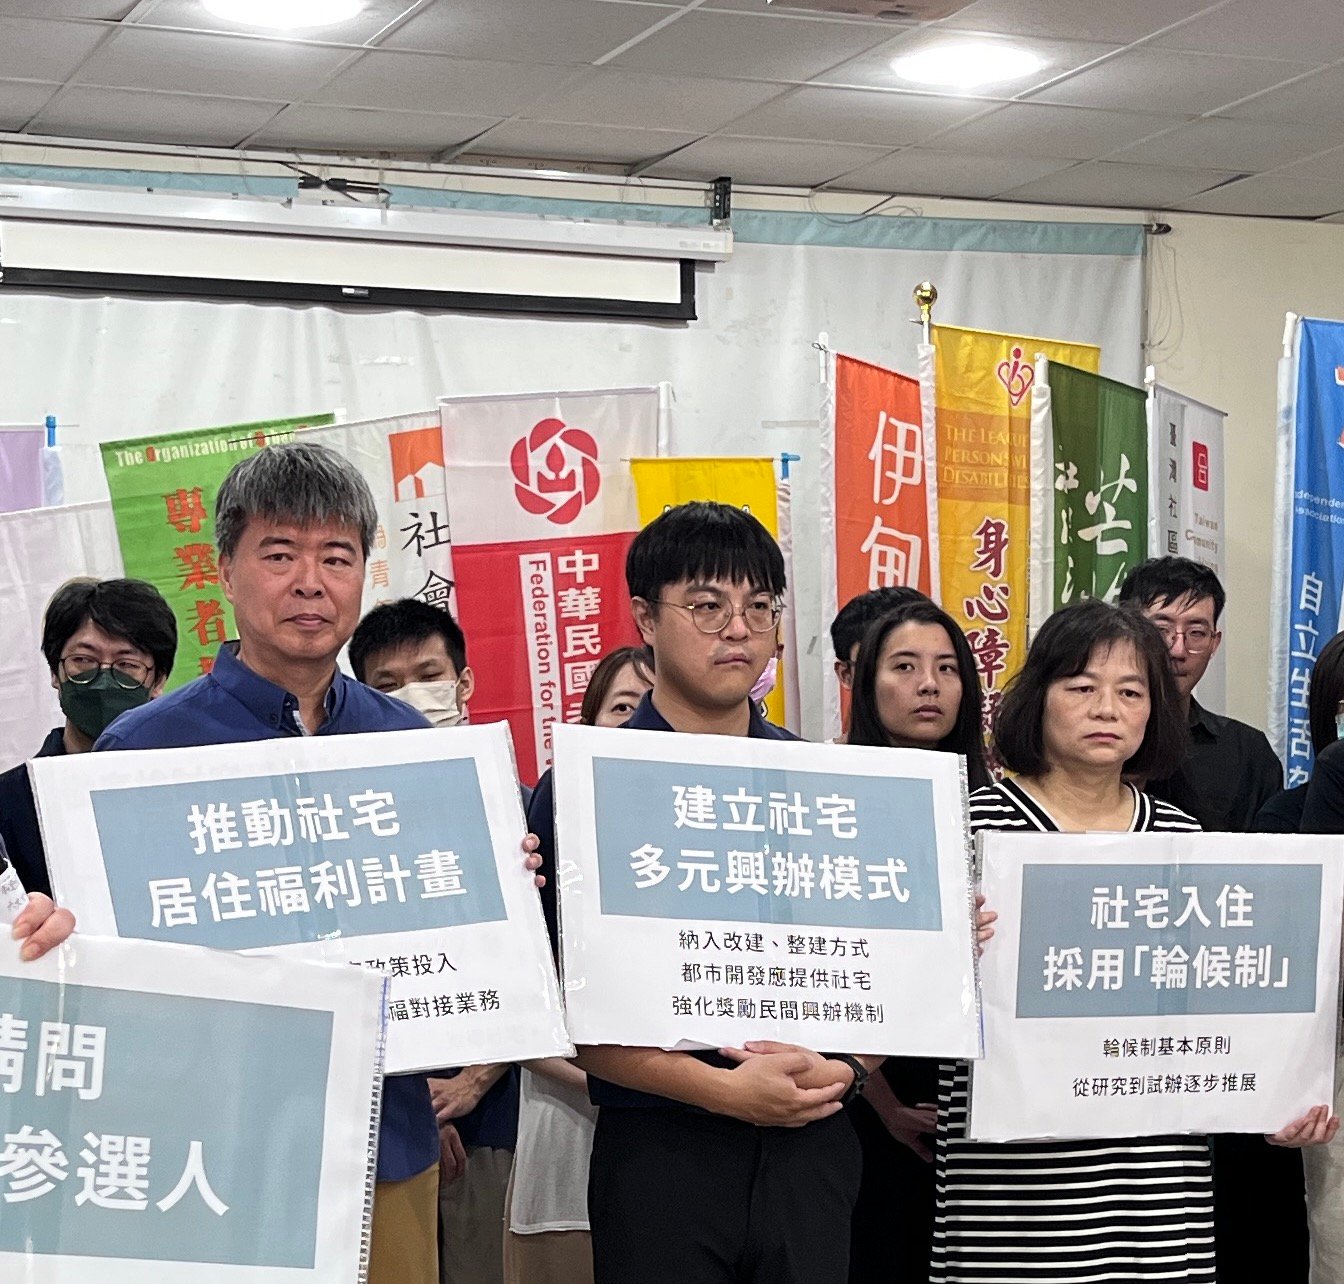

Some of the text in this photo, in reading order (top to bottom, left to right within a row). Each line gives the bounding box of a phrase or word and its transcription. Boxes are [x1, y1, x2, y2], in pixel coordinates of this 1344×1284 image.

[116, 450, 144, 467] The
[146, 439, 238, 463] Organization
[162, 486, 227, 676] 專業者
[528, 559, 554, 674] Federation
[539, 679, 556, 710] for
[187, 789, 400, 855] 推動社宅
[672, 785, 858, 839] 建立社宅
[148, 849, 467, 928] 居住福利計畫
[630, 843, 910, 903] 多元興辦模式
[1090, 884, 1255, 930] 社宅入住
[678, 929, 871, 958] 納入改建、整建方式
[681, 962, 873, 991] 都市開發應提供社宅
[1043, 944, 1290, 991] 採用「輪候制」
[1103, 1035, 1232, 1058] 輪候制基本原則
[1072, 1072, 1257, 1098] 從研究到試辦逐步推展
